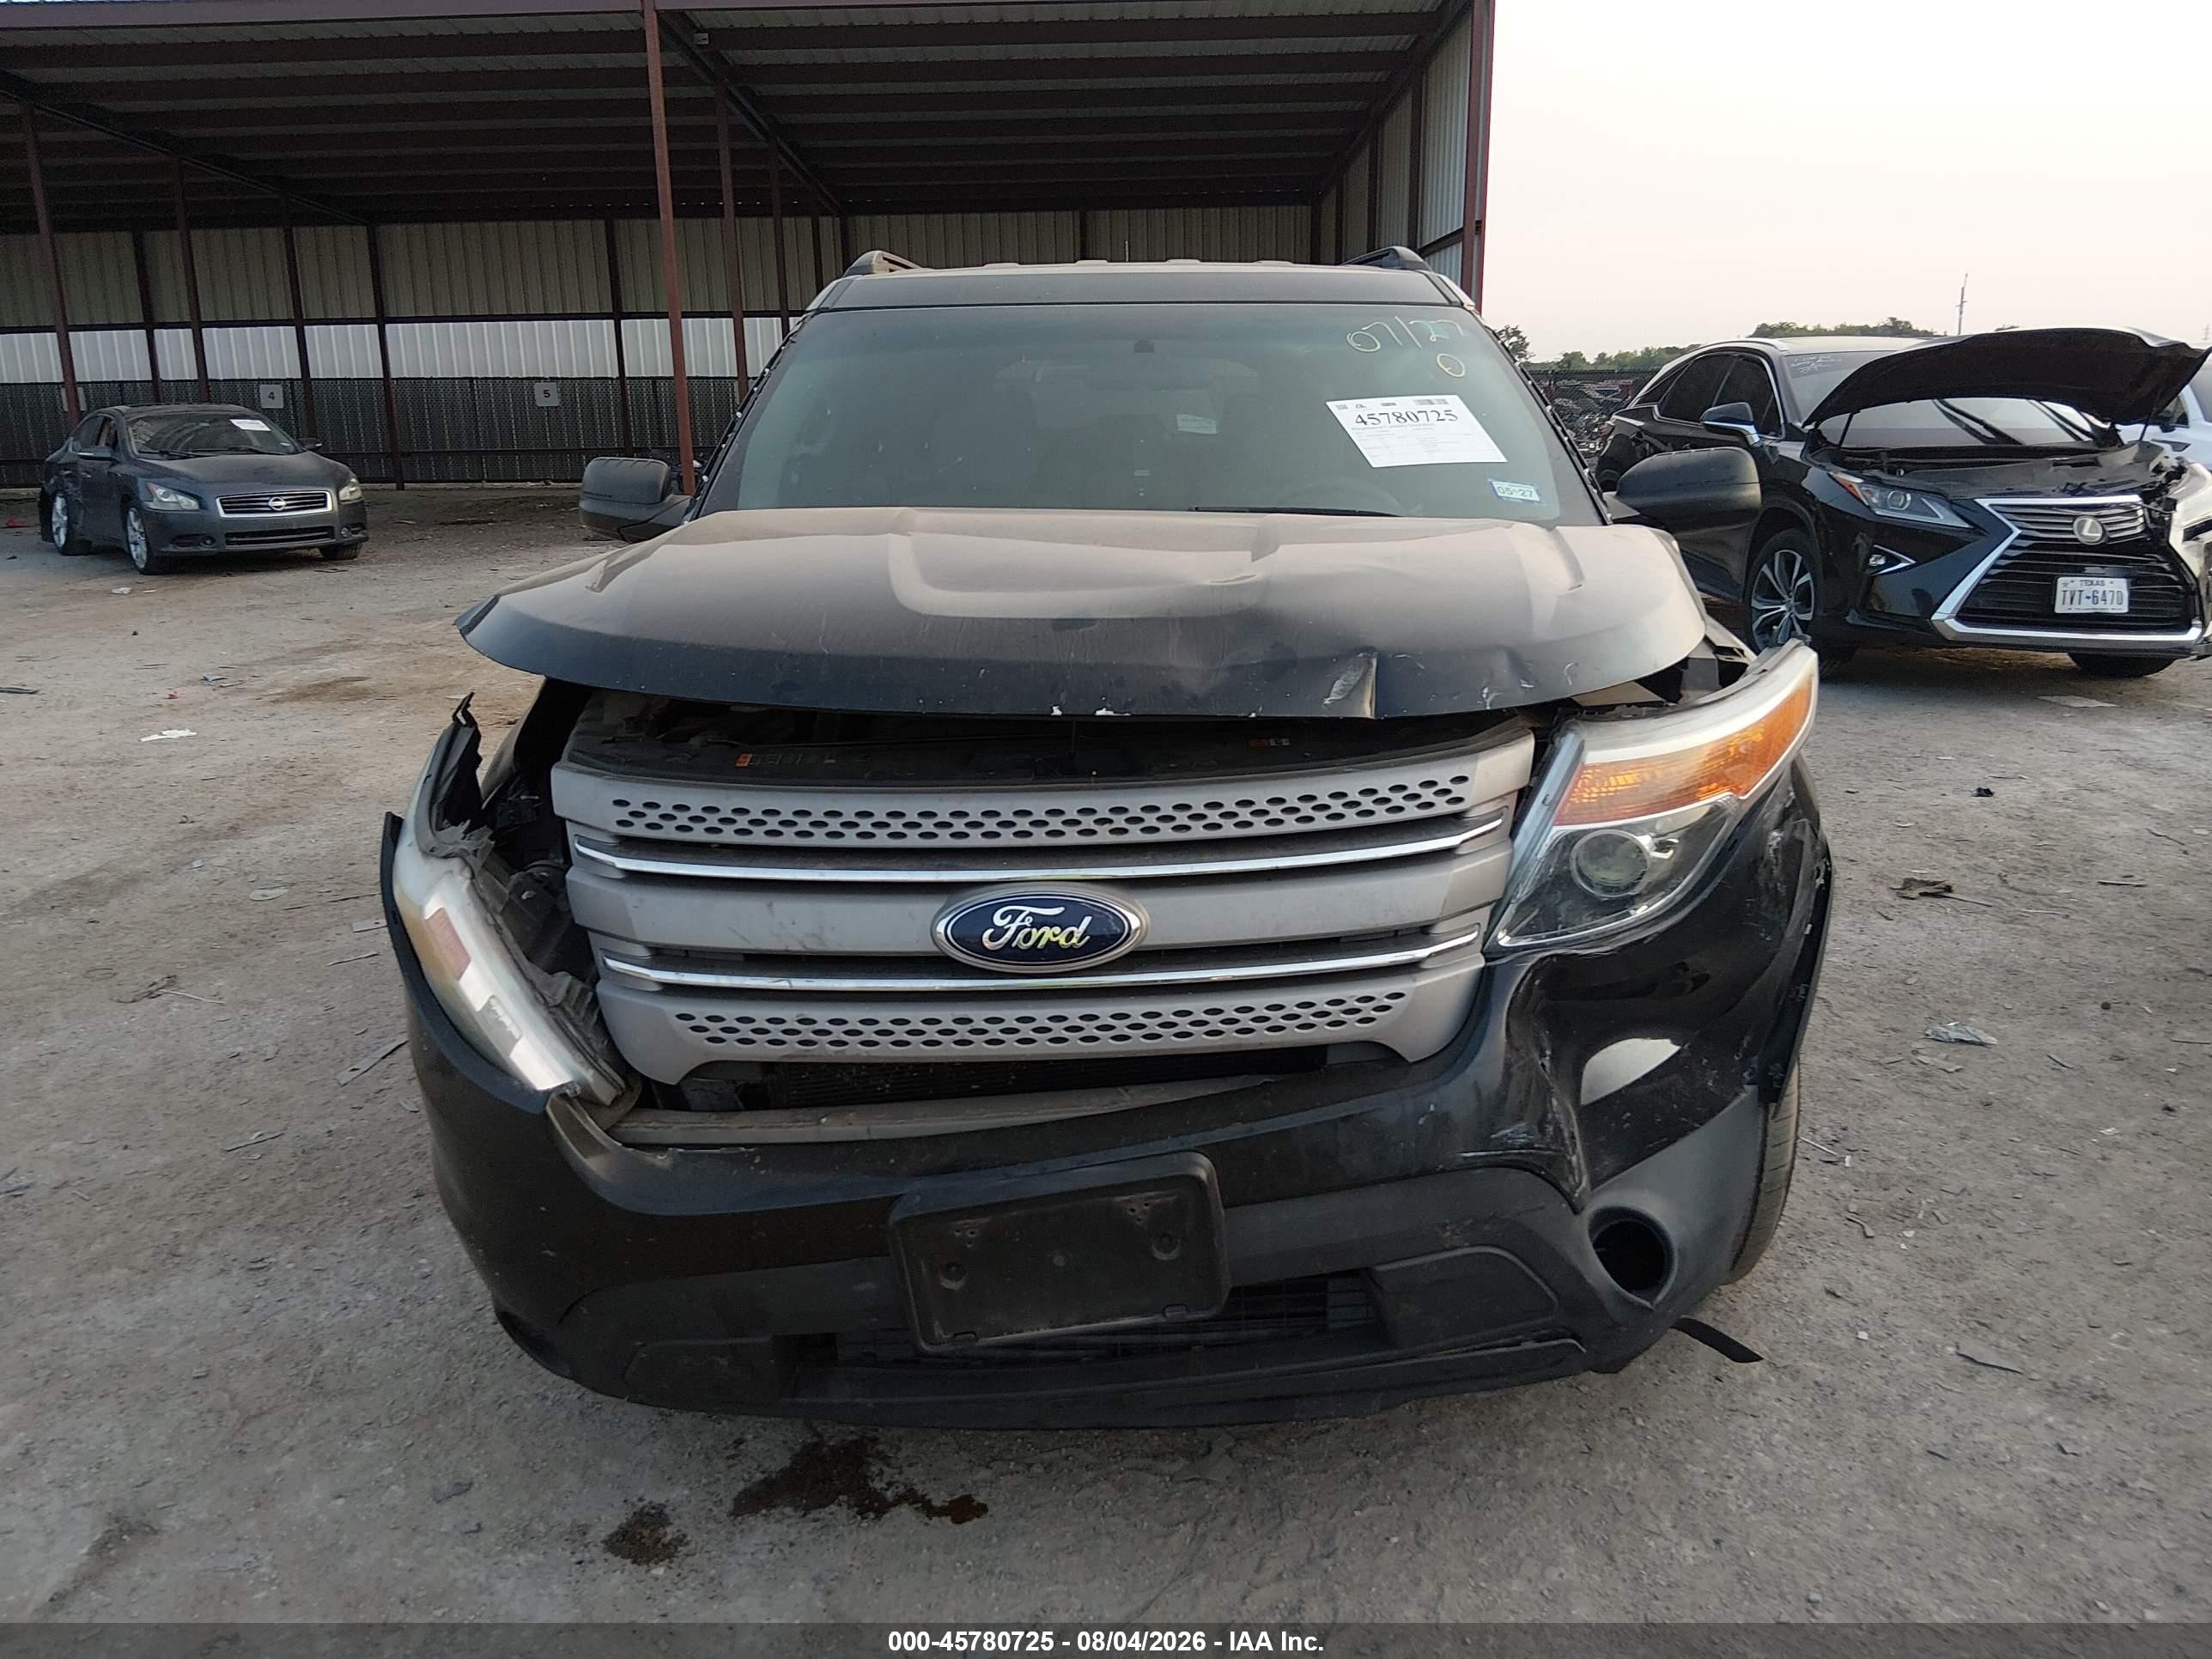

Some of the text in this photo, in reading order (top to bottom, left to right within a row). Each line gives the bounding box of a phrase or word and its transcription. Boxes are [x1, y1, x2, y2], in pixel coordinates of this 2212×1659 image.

[267, 392, 276, 400] 4
[543, 389, 550, 398] 5
[1354, 410, 1458, 426] 45780725
[981, 905, 1093, 951] Ford
